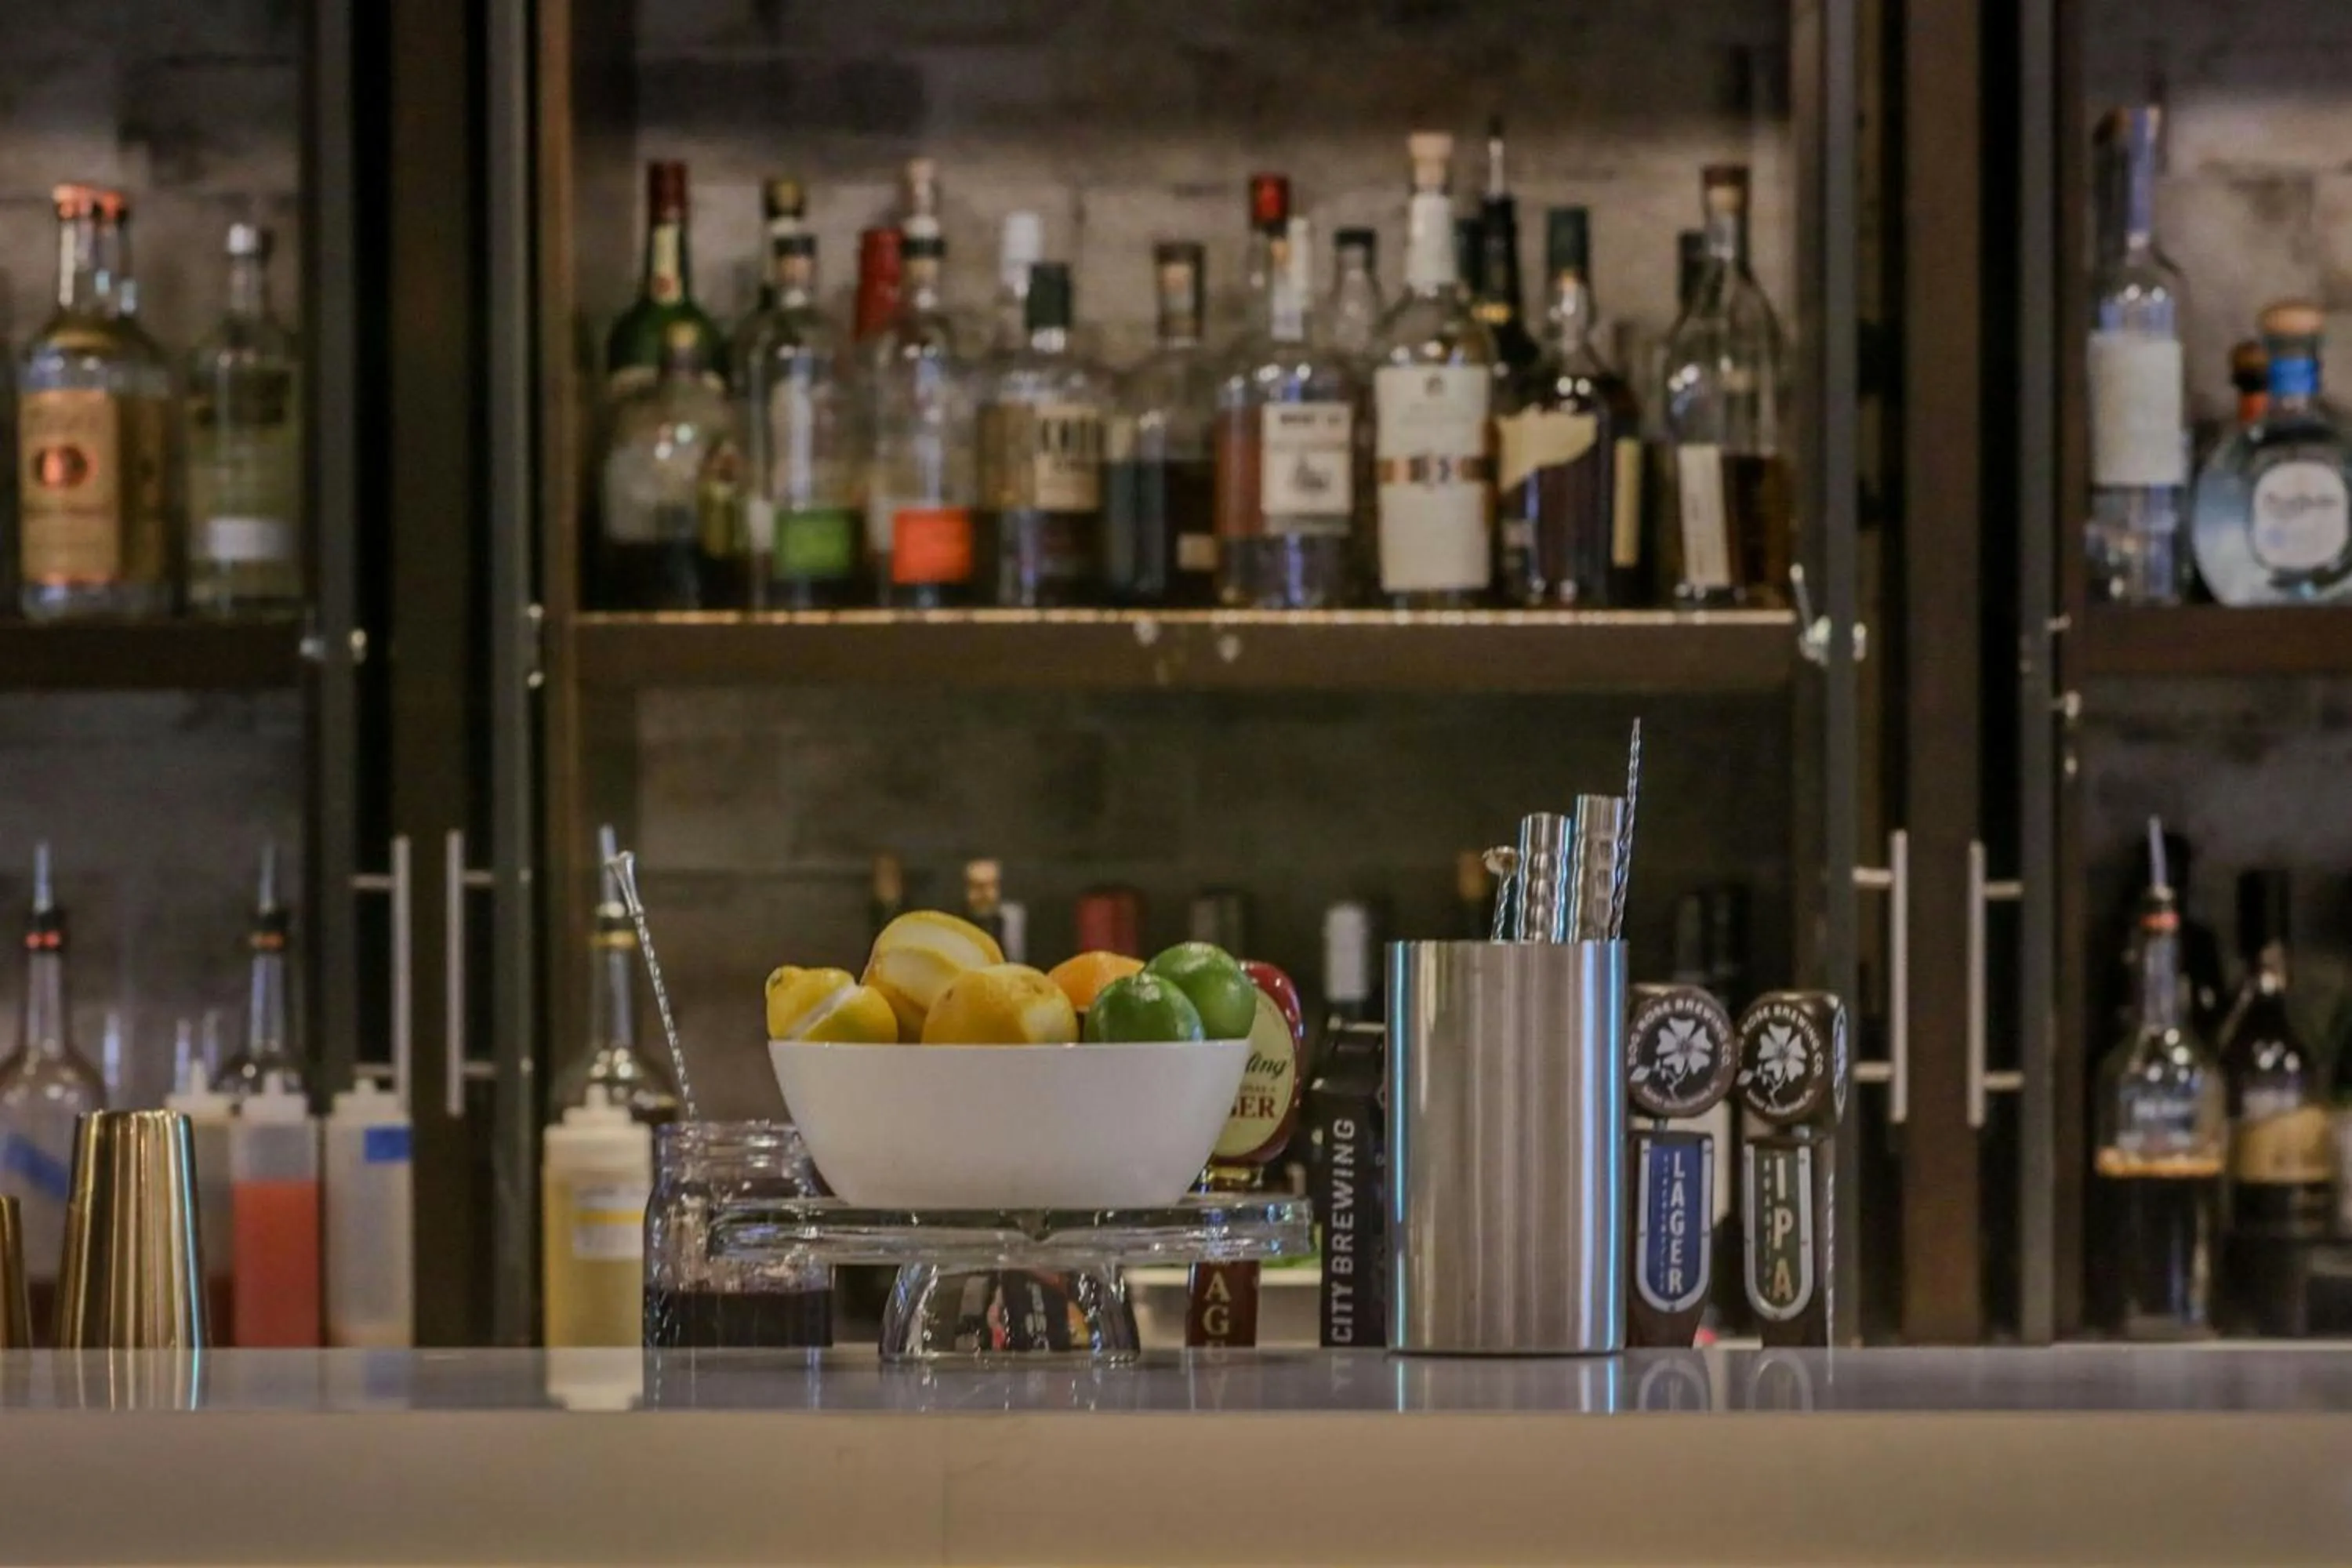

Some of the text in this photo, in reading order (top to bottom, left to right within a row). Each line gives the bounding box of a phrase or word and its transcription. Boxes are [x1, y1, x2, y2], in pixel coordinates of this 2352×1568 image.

[1636, 1000, 1671, 1033] ROSE
[1675, 997, 1729, 1043] BREWING
[1741, 1005, 1771, 1035] ROSE
[1773, 1003, 1820, 1051] BREWING
[1331, 1118, 1356, 1344] CITY BREWING
[1668, 1150, 1686, 1295] LAGER
[1772, 1156, 1795, 1302] IPA
